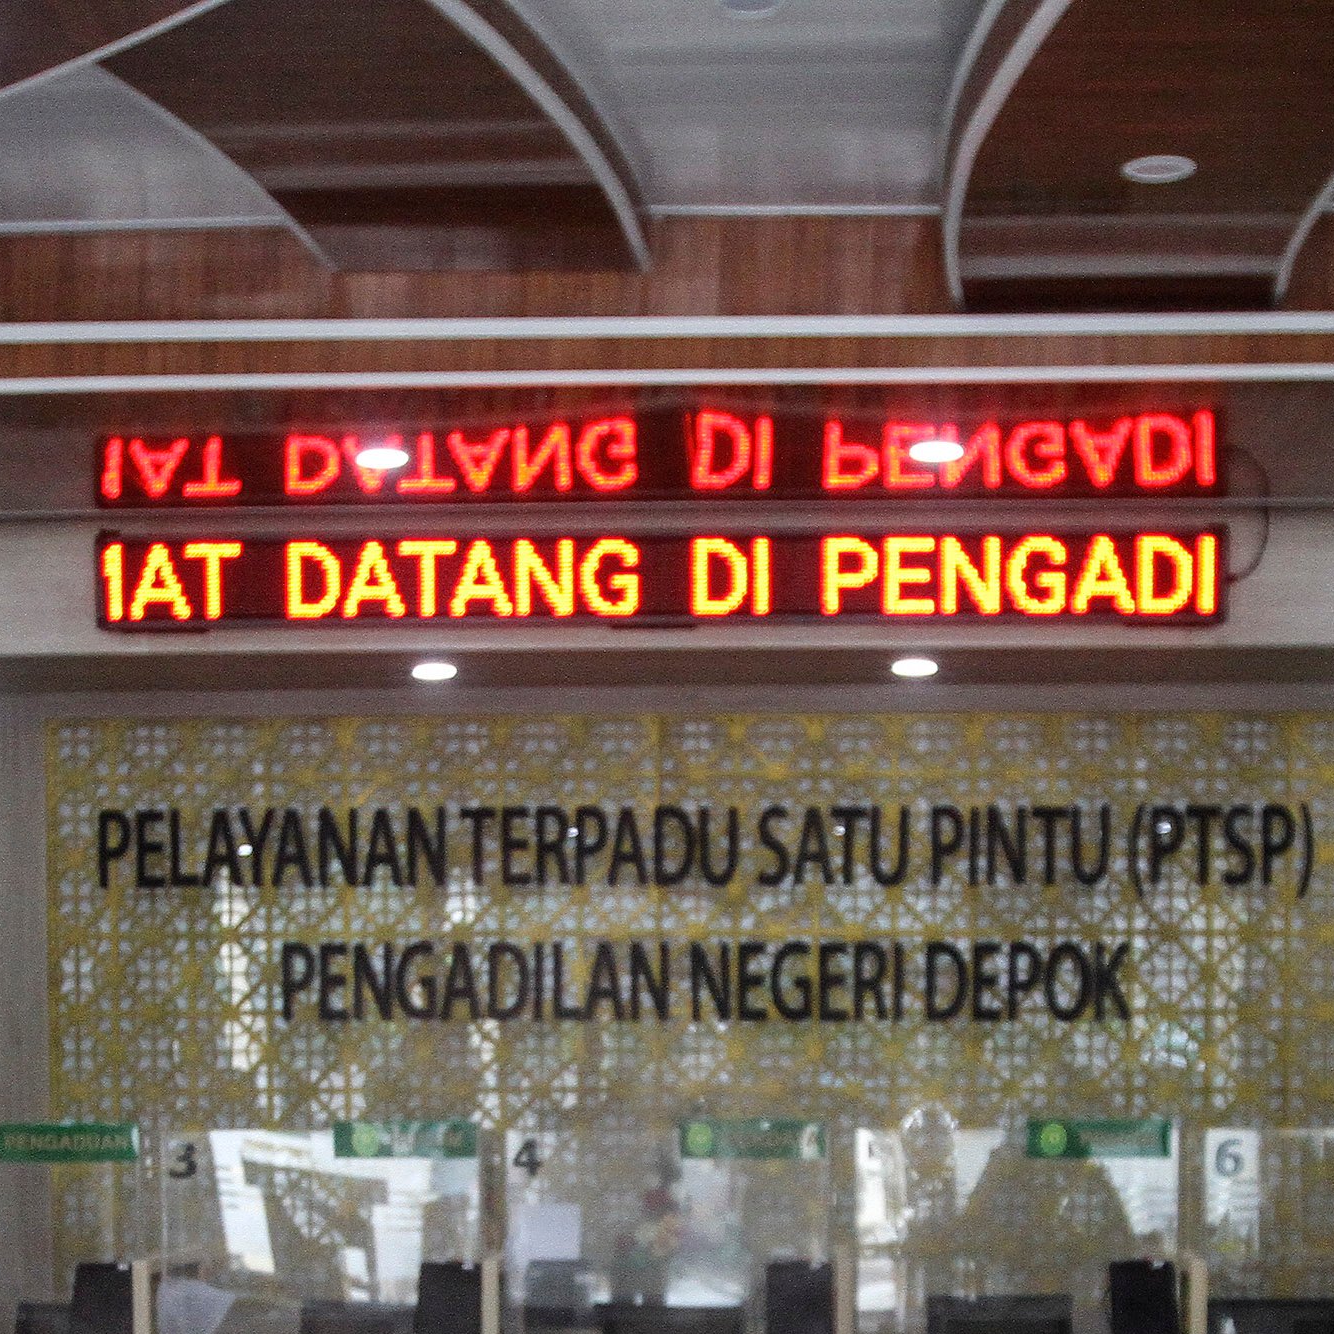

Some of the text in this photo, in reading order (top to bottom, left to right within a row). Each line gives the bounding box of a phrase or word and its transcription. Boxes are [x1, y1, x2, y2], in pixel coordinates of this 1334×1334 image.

[285, 538, 641, 619] DATANG
[690, 536, 771, 617] DI
[820, 535, 1217, 615] PENGADI
[98, 803, 1313, 899] PELAYANAN TERPADU SATU PINTU (PTSP)
[280, 941, 1131, 1022] PENGADILAN NEGERI DEPOK
[168, 1140, 198, 1179] 3
[512, 1138, 542, 1177] 4
[1214, 1137, 1245, 1178] 6
